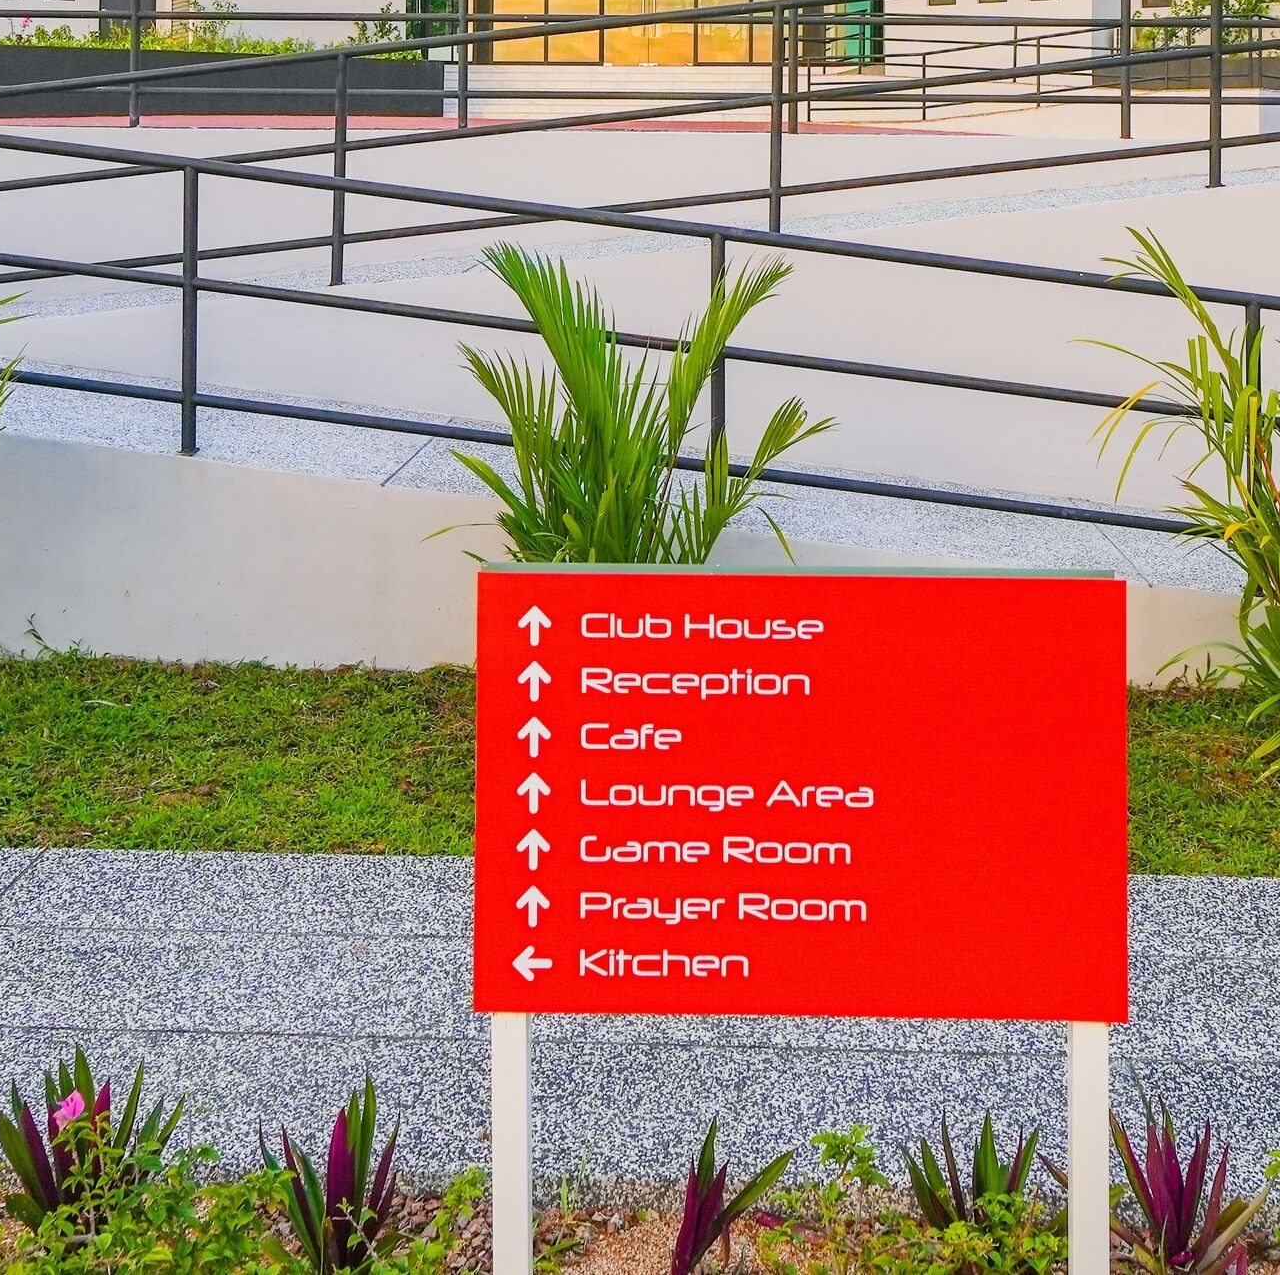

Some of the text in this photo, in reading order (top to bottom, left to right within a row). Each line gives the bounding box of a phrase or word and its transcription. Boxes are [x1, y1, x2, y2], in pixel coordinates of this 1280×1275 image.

[580, 612, 824, 640] Club House
[581, 667, 811, 700] Reception
[580, 722, 682, 750] Cafe
[580, 779, 874, 812] Lounge Area
[579, 835, 852, 865] Game Room
[579, 891, 867, 925] Prayer Room
[579, 948, 749, 978] Kitchen
